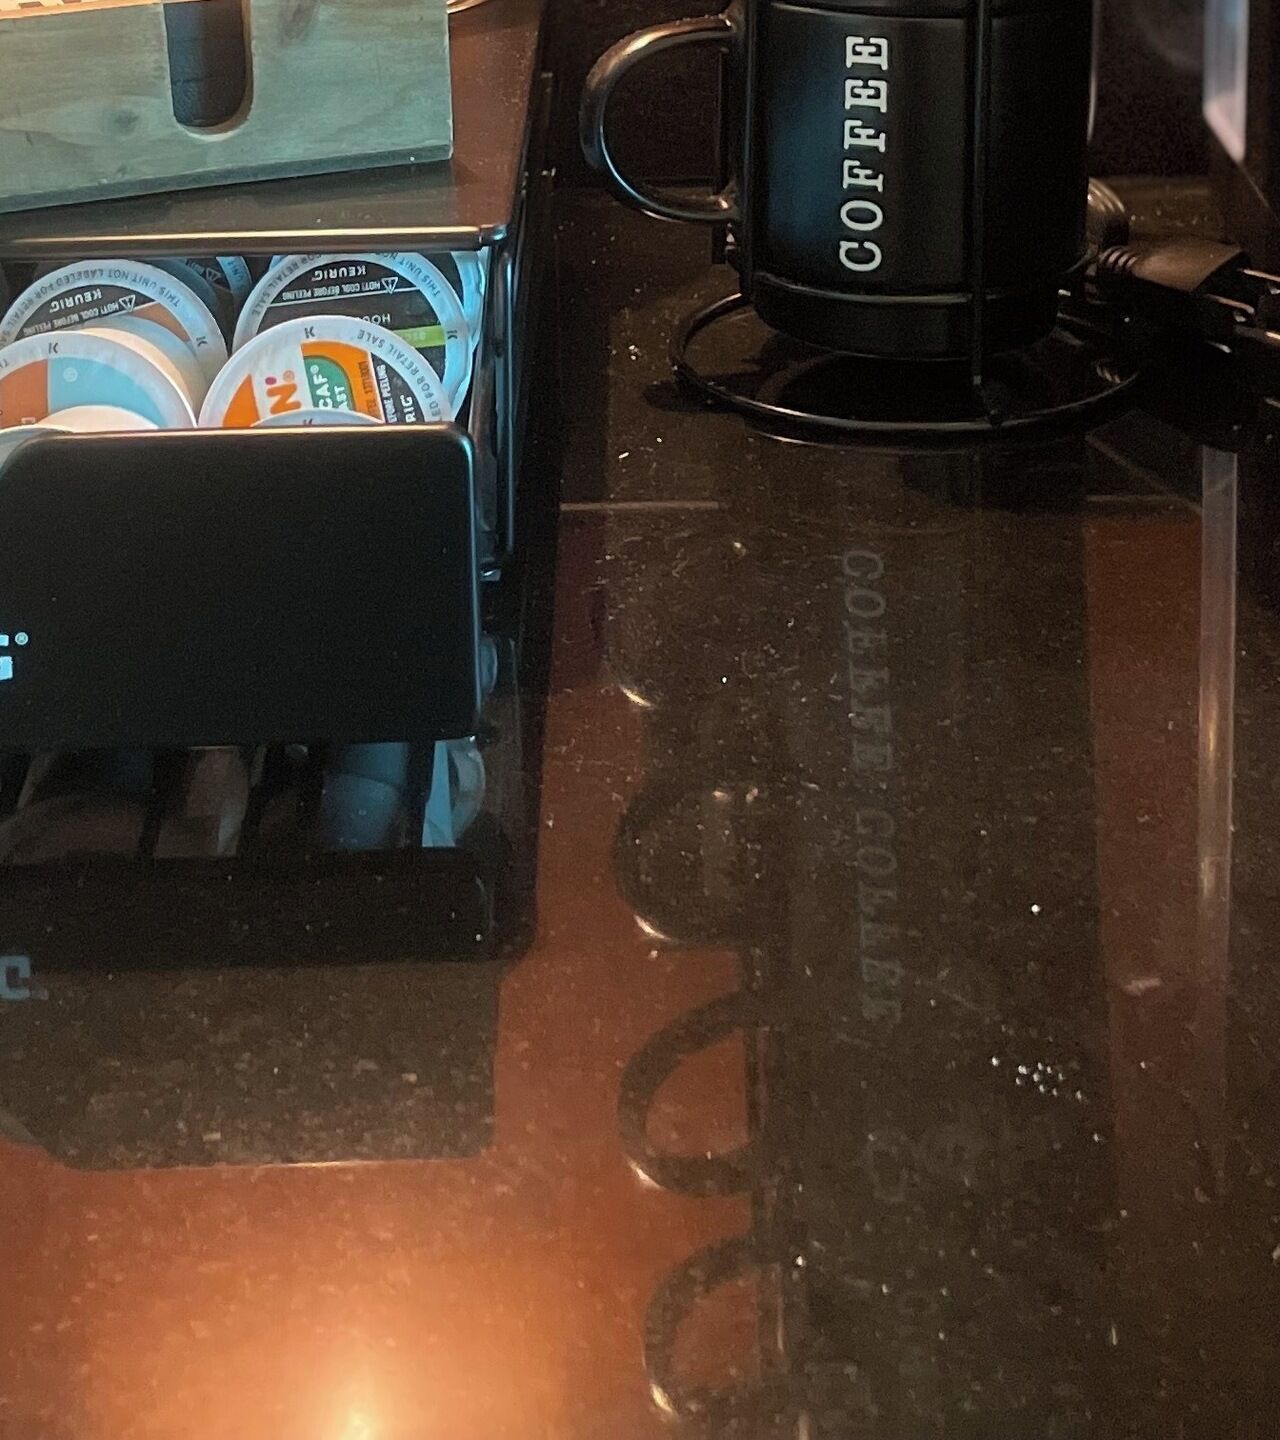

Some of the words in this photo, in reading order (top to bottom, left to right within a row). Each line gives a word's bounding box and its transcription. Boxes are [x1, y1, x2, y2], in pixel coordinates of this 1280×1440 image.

[839, 35, 889, 273] COFFEE
[314, 265, 367, 281] KEURIG
[50, 288, 102, 311] KEURIG
[357, 329, 386, 349] SALE
[384, 398, 398, 423] EFORE
[400, 394, 417, 423] RIG
